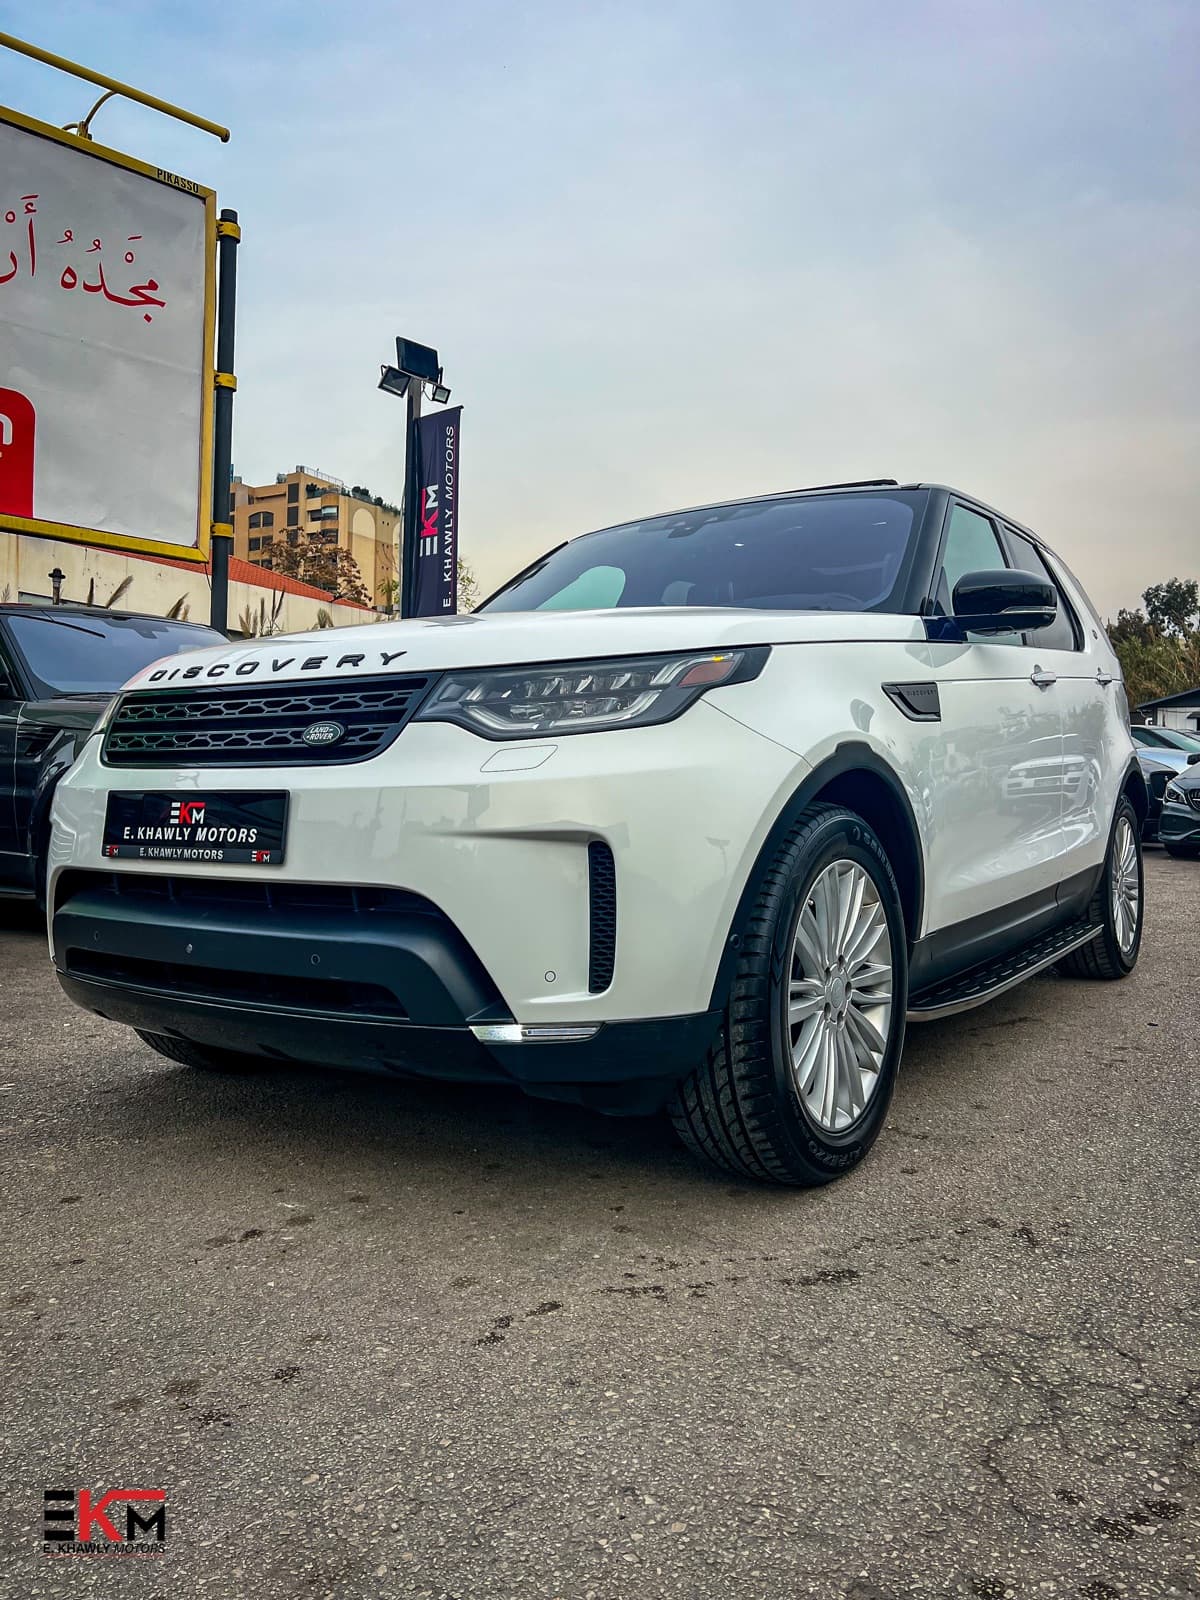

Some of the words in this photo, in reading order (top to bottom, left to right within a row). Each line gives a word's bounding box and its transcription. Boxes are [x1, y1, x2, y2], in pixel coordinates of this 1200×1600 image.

[157, 168, 199, 193] PIKASSO
[445, 425, 455, 500] MOTORS
[443, 508, 454, 582] KHAWLY
[442, 590, 452, 608] E.
[148, 650, 407, 682] DISCOVERY
[123, 826, 135, 840] E.
[137, 826, 192, 841] KHAWLY
[195, 827, 258, 843] MOTORS
[139, 847, 147, 857] E.
[148, 847, 183, 859] KHAWLY
[183, 849, 224, 860] MOTORS
